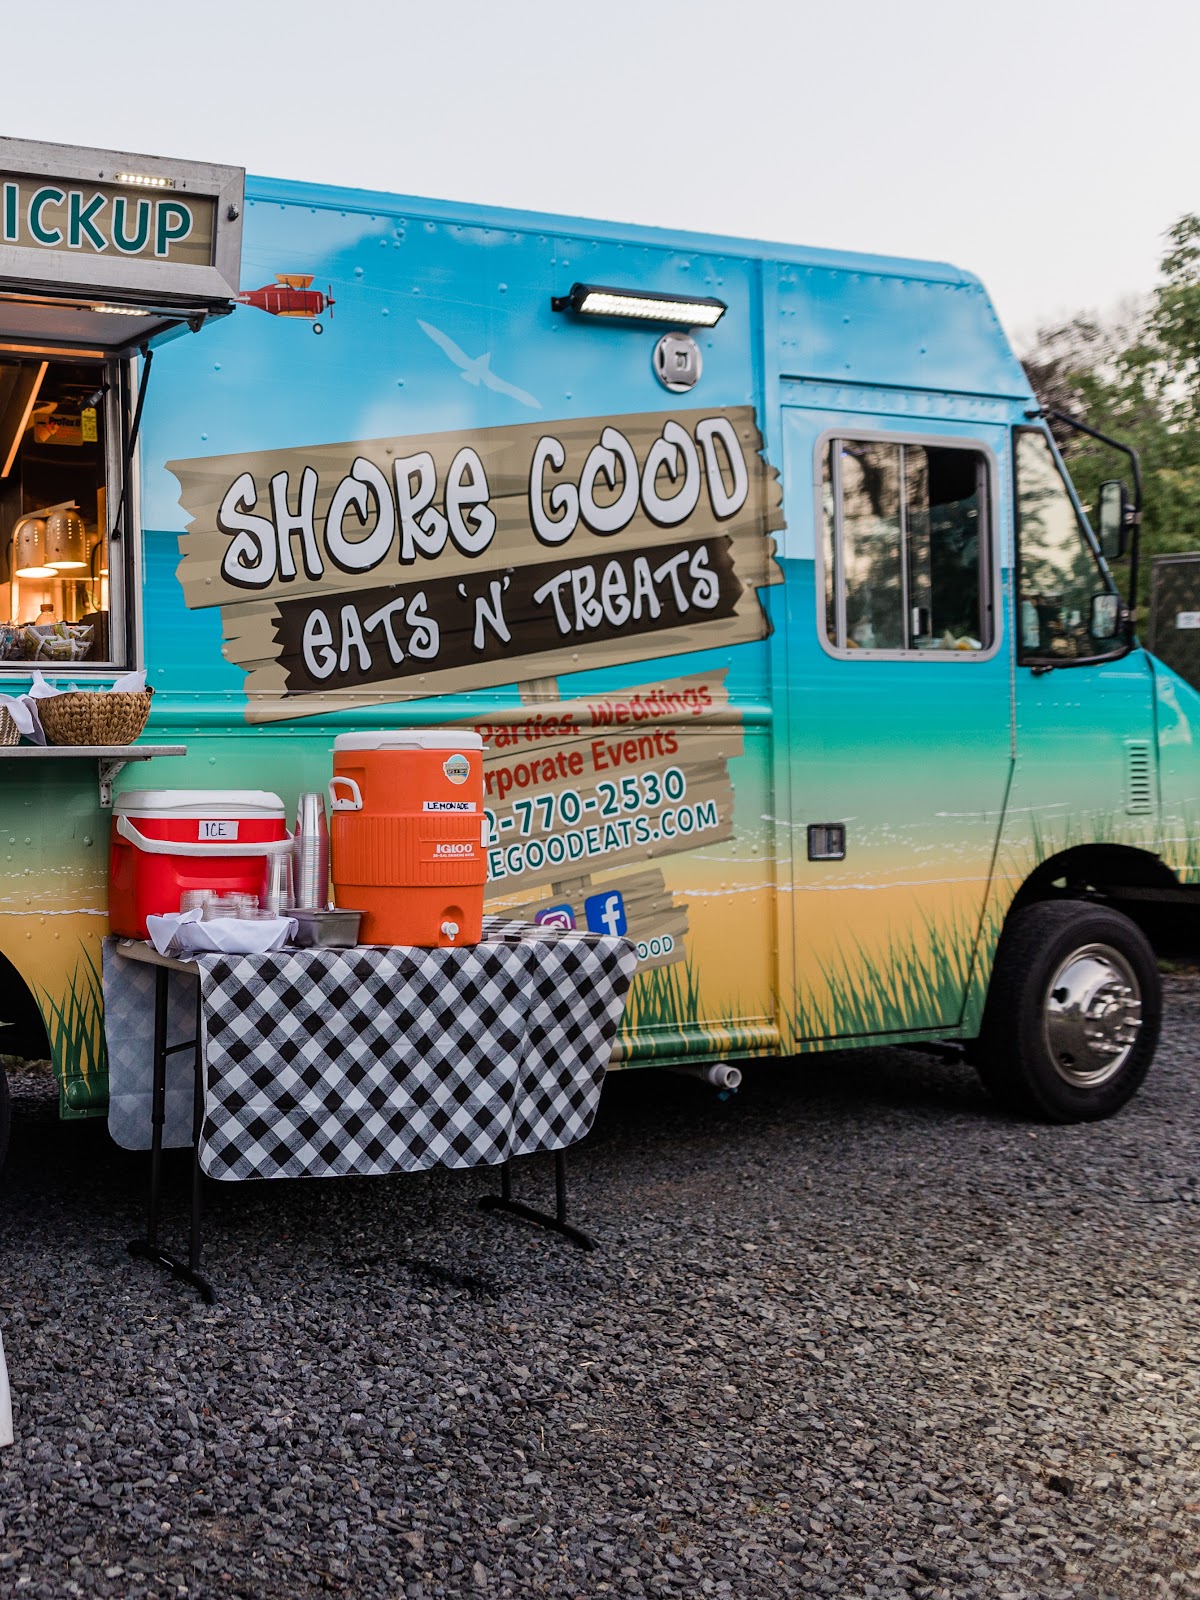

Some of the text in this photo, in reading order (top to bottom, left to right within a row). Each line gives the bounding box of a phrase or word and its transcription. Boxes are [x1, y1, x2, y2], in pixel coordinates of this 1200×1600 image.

[218, 416, 751, 588] SHORE GOOD
[301, 592, 440, 681] EATS
[534, 545, 720, 636] TREATS
[587, 685, 713, 728] Weddings
[485, 729, 679, 800] rporate Events
[205, 822, 228, 837] ICE
[427, 802, 470, 811] LEMONADE
[483, 769, 685, 843] 2-770-2530
[435, 843, 473, 855] IGLOO
[487, 801, 718, 879] EGOODEATS.COM
[637, 936, 674, 959] OOD
